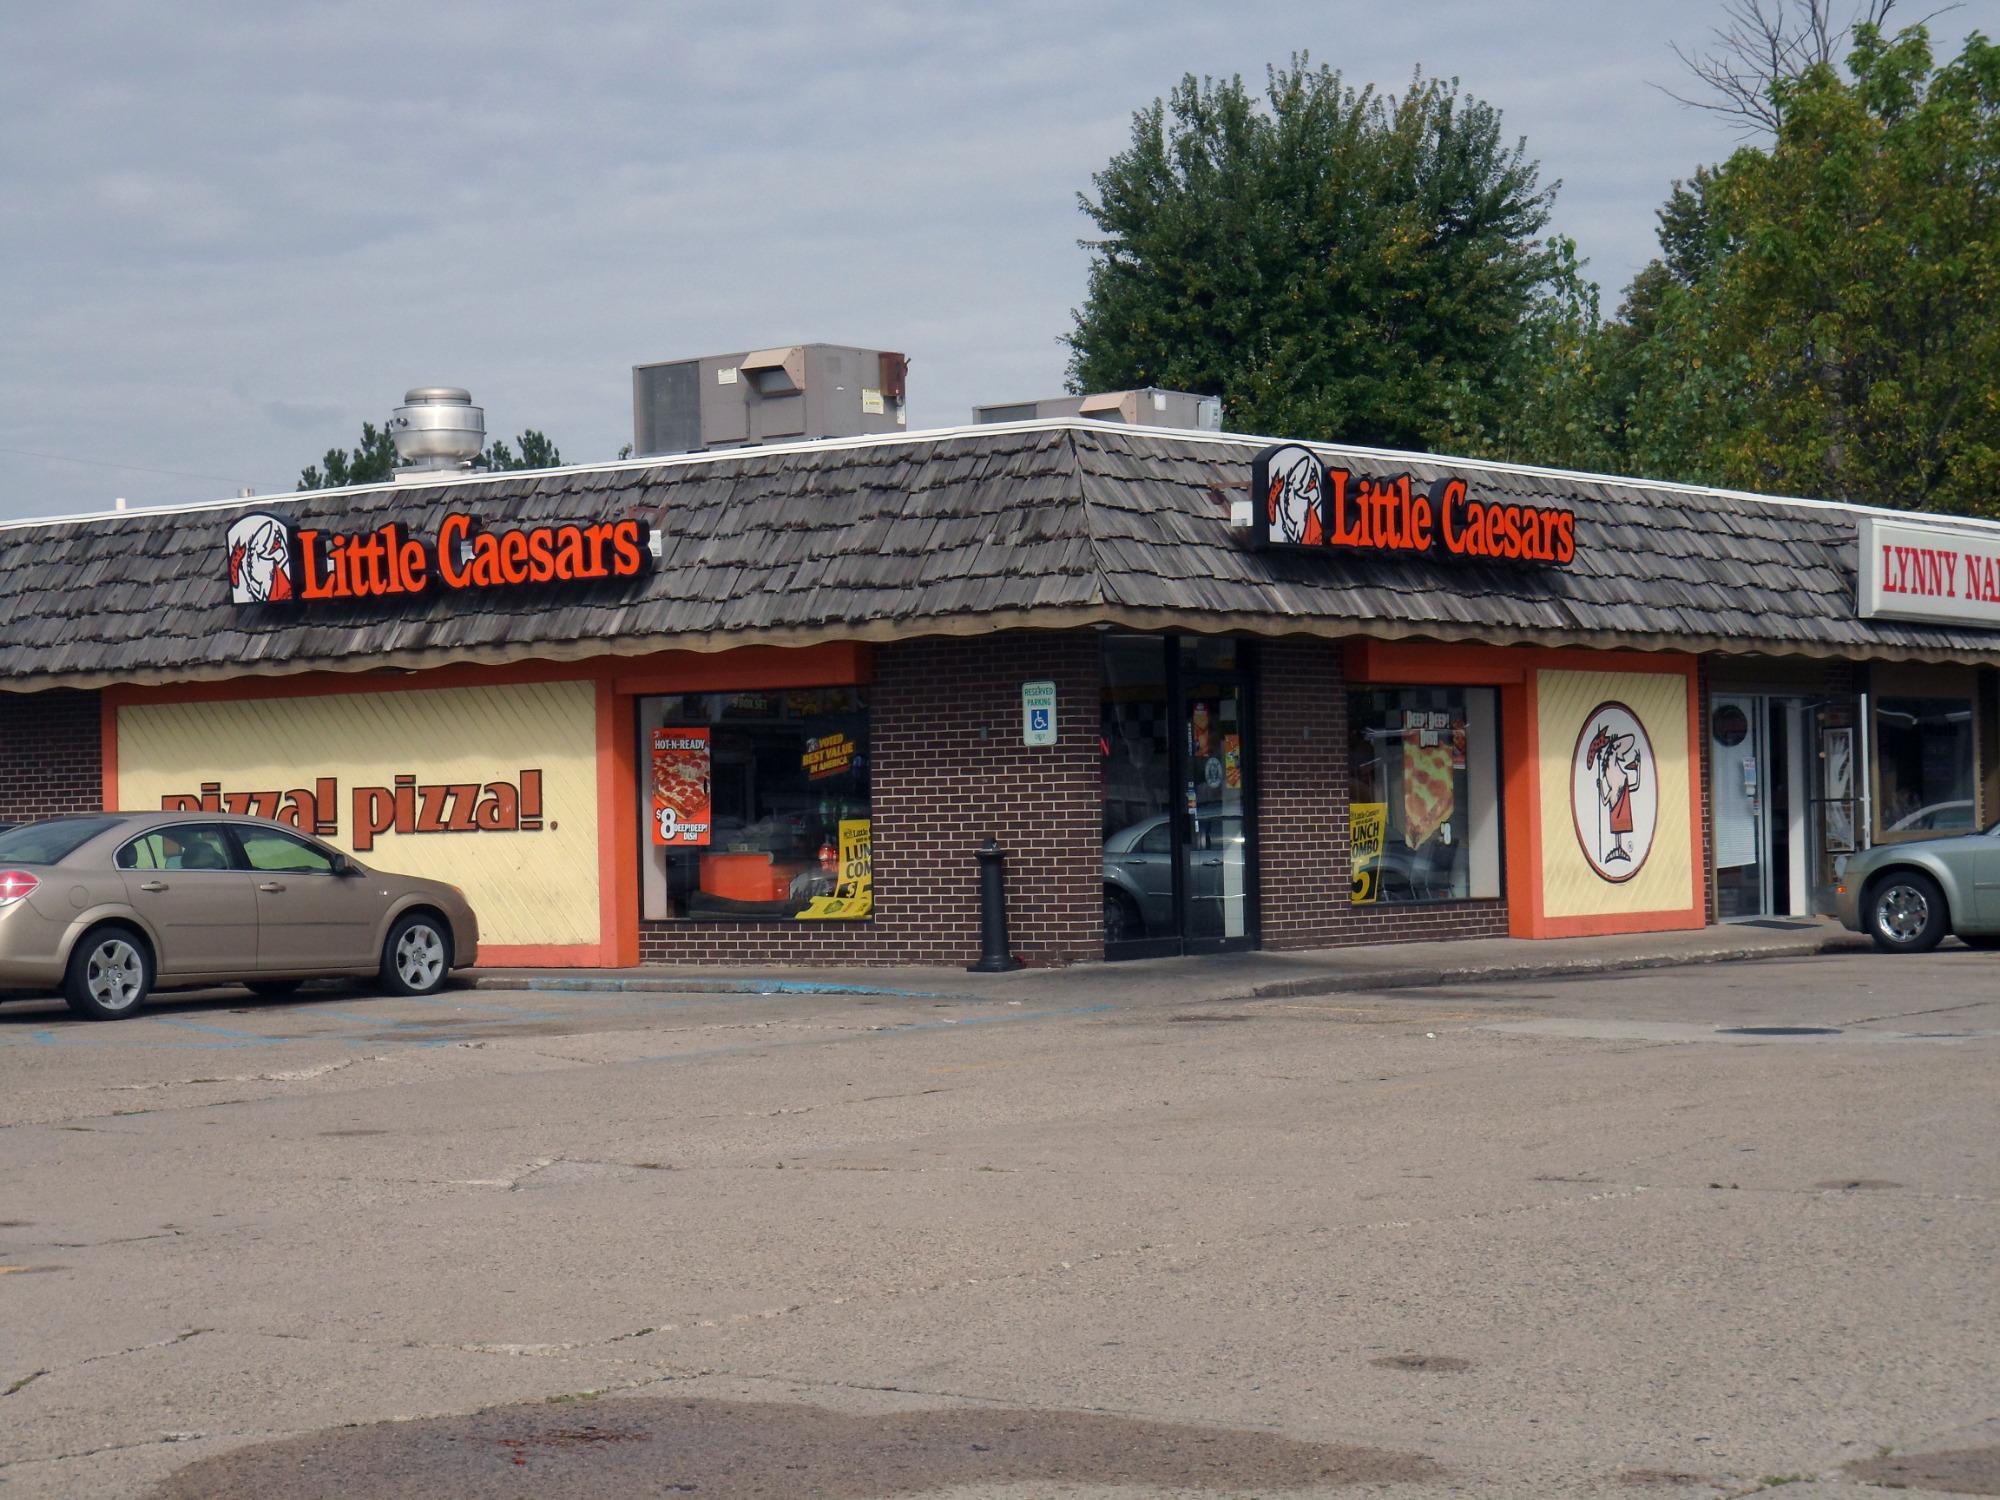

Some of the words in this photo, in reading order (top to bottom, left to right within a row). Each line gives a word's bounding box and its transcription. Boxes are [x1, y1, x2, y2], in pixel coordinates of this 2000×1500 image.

[1329, 470, 1432, 550] Little
[1441, 479, 1576, 563] Caesars
[299, 520, 428, 599] Little
[438, 513, 641, 589] Caesars
[1882, 545, 1958, 598] LYNNY
[1024, 687, 1054, 697] RESERVED
[655, 739, 706, 750] HOT-N-READY
[802, 751, 825, 768] BEST
[825, 742, 855, 761] VALUE
[352, 768, 543, 851] pizza!
[1352, 821, 1380, 843] UNCH
[1351, 839, 1379, 859] OMBO
